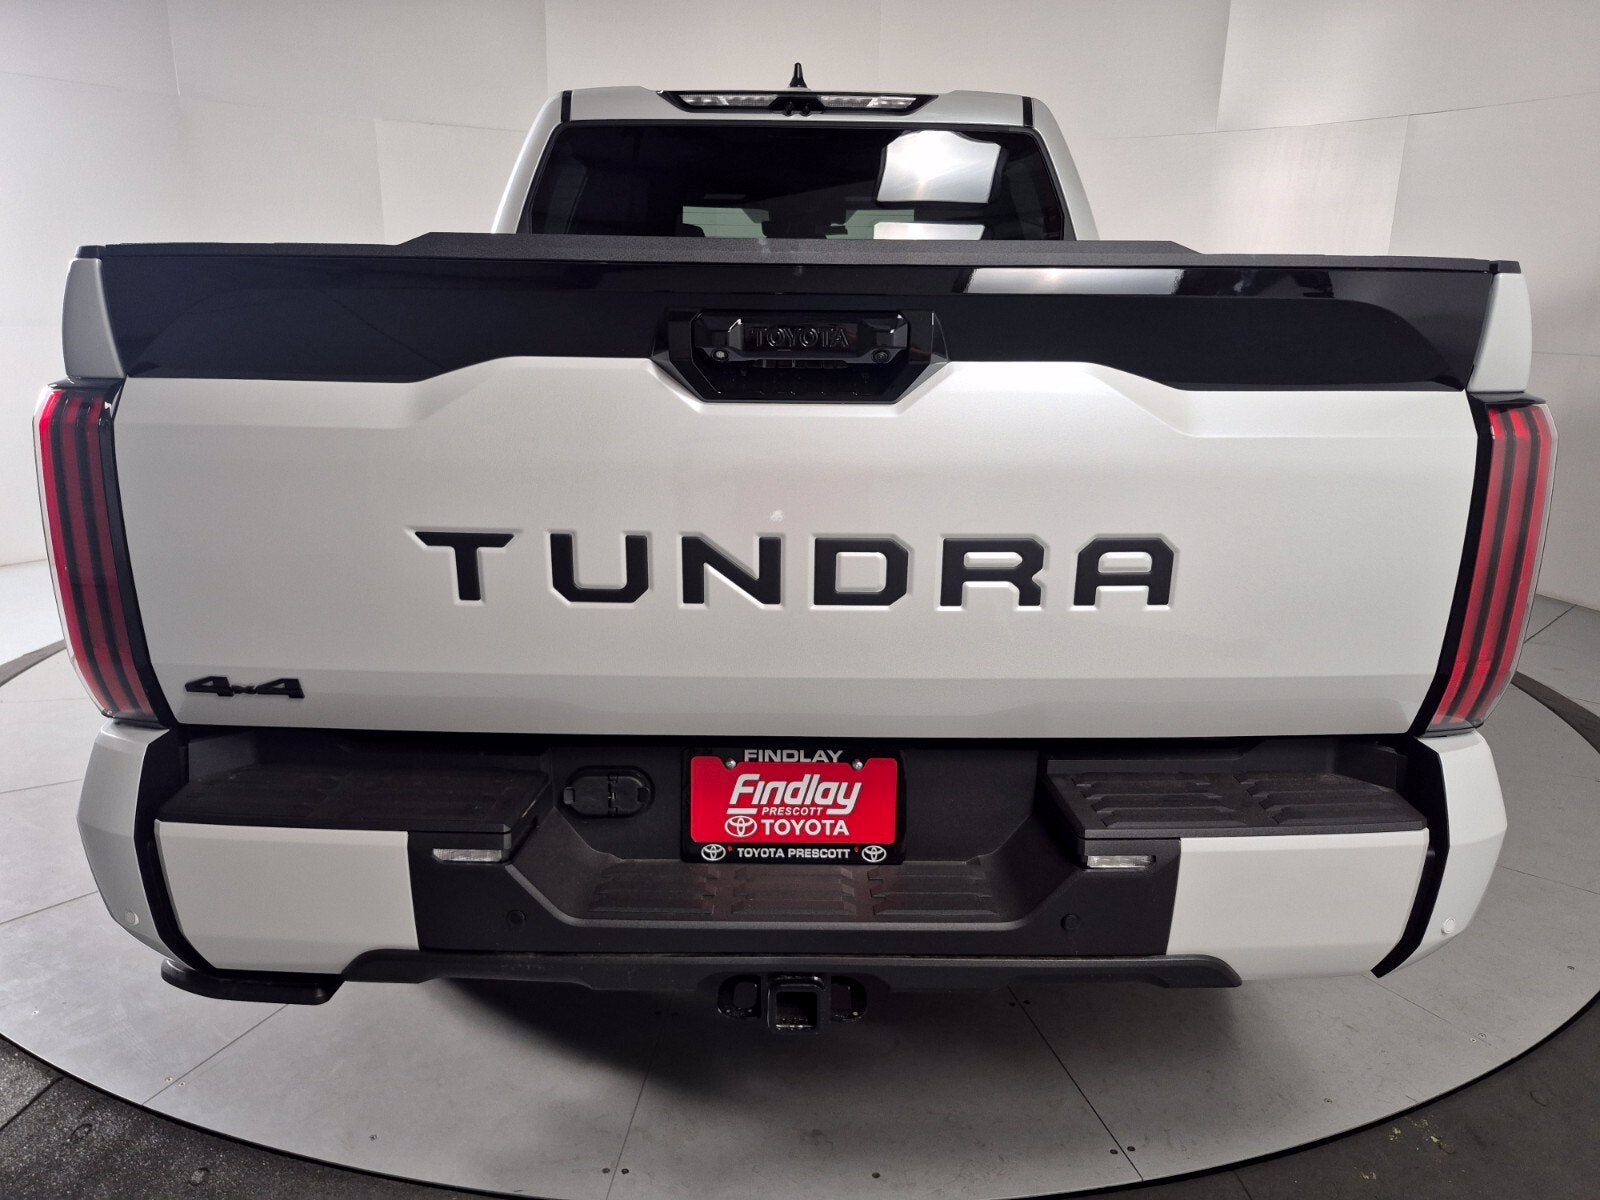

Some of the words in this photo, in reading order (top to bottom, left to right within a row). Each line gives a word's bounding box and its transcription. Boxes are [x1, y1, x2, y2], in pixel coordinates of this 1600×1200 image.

[751, 327, 848, 348] TOYOTA
[413, 531, 1176, 609] TUNDRA
[743, 749, 844, 764] FINDLAY
[729, 773, 863, 815] Findlay
[761, 807, 823, 816] PRESCOTT
[760, 819, 850, 836] TOYOTA
[737, 847, 785, 858] TOYOTA
[788, 848, 851, 859] PRESCOTT
